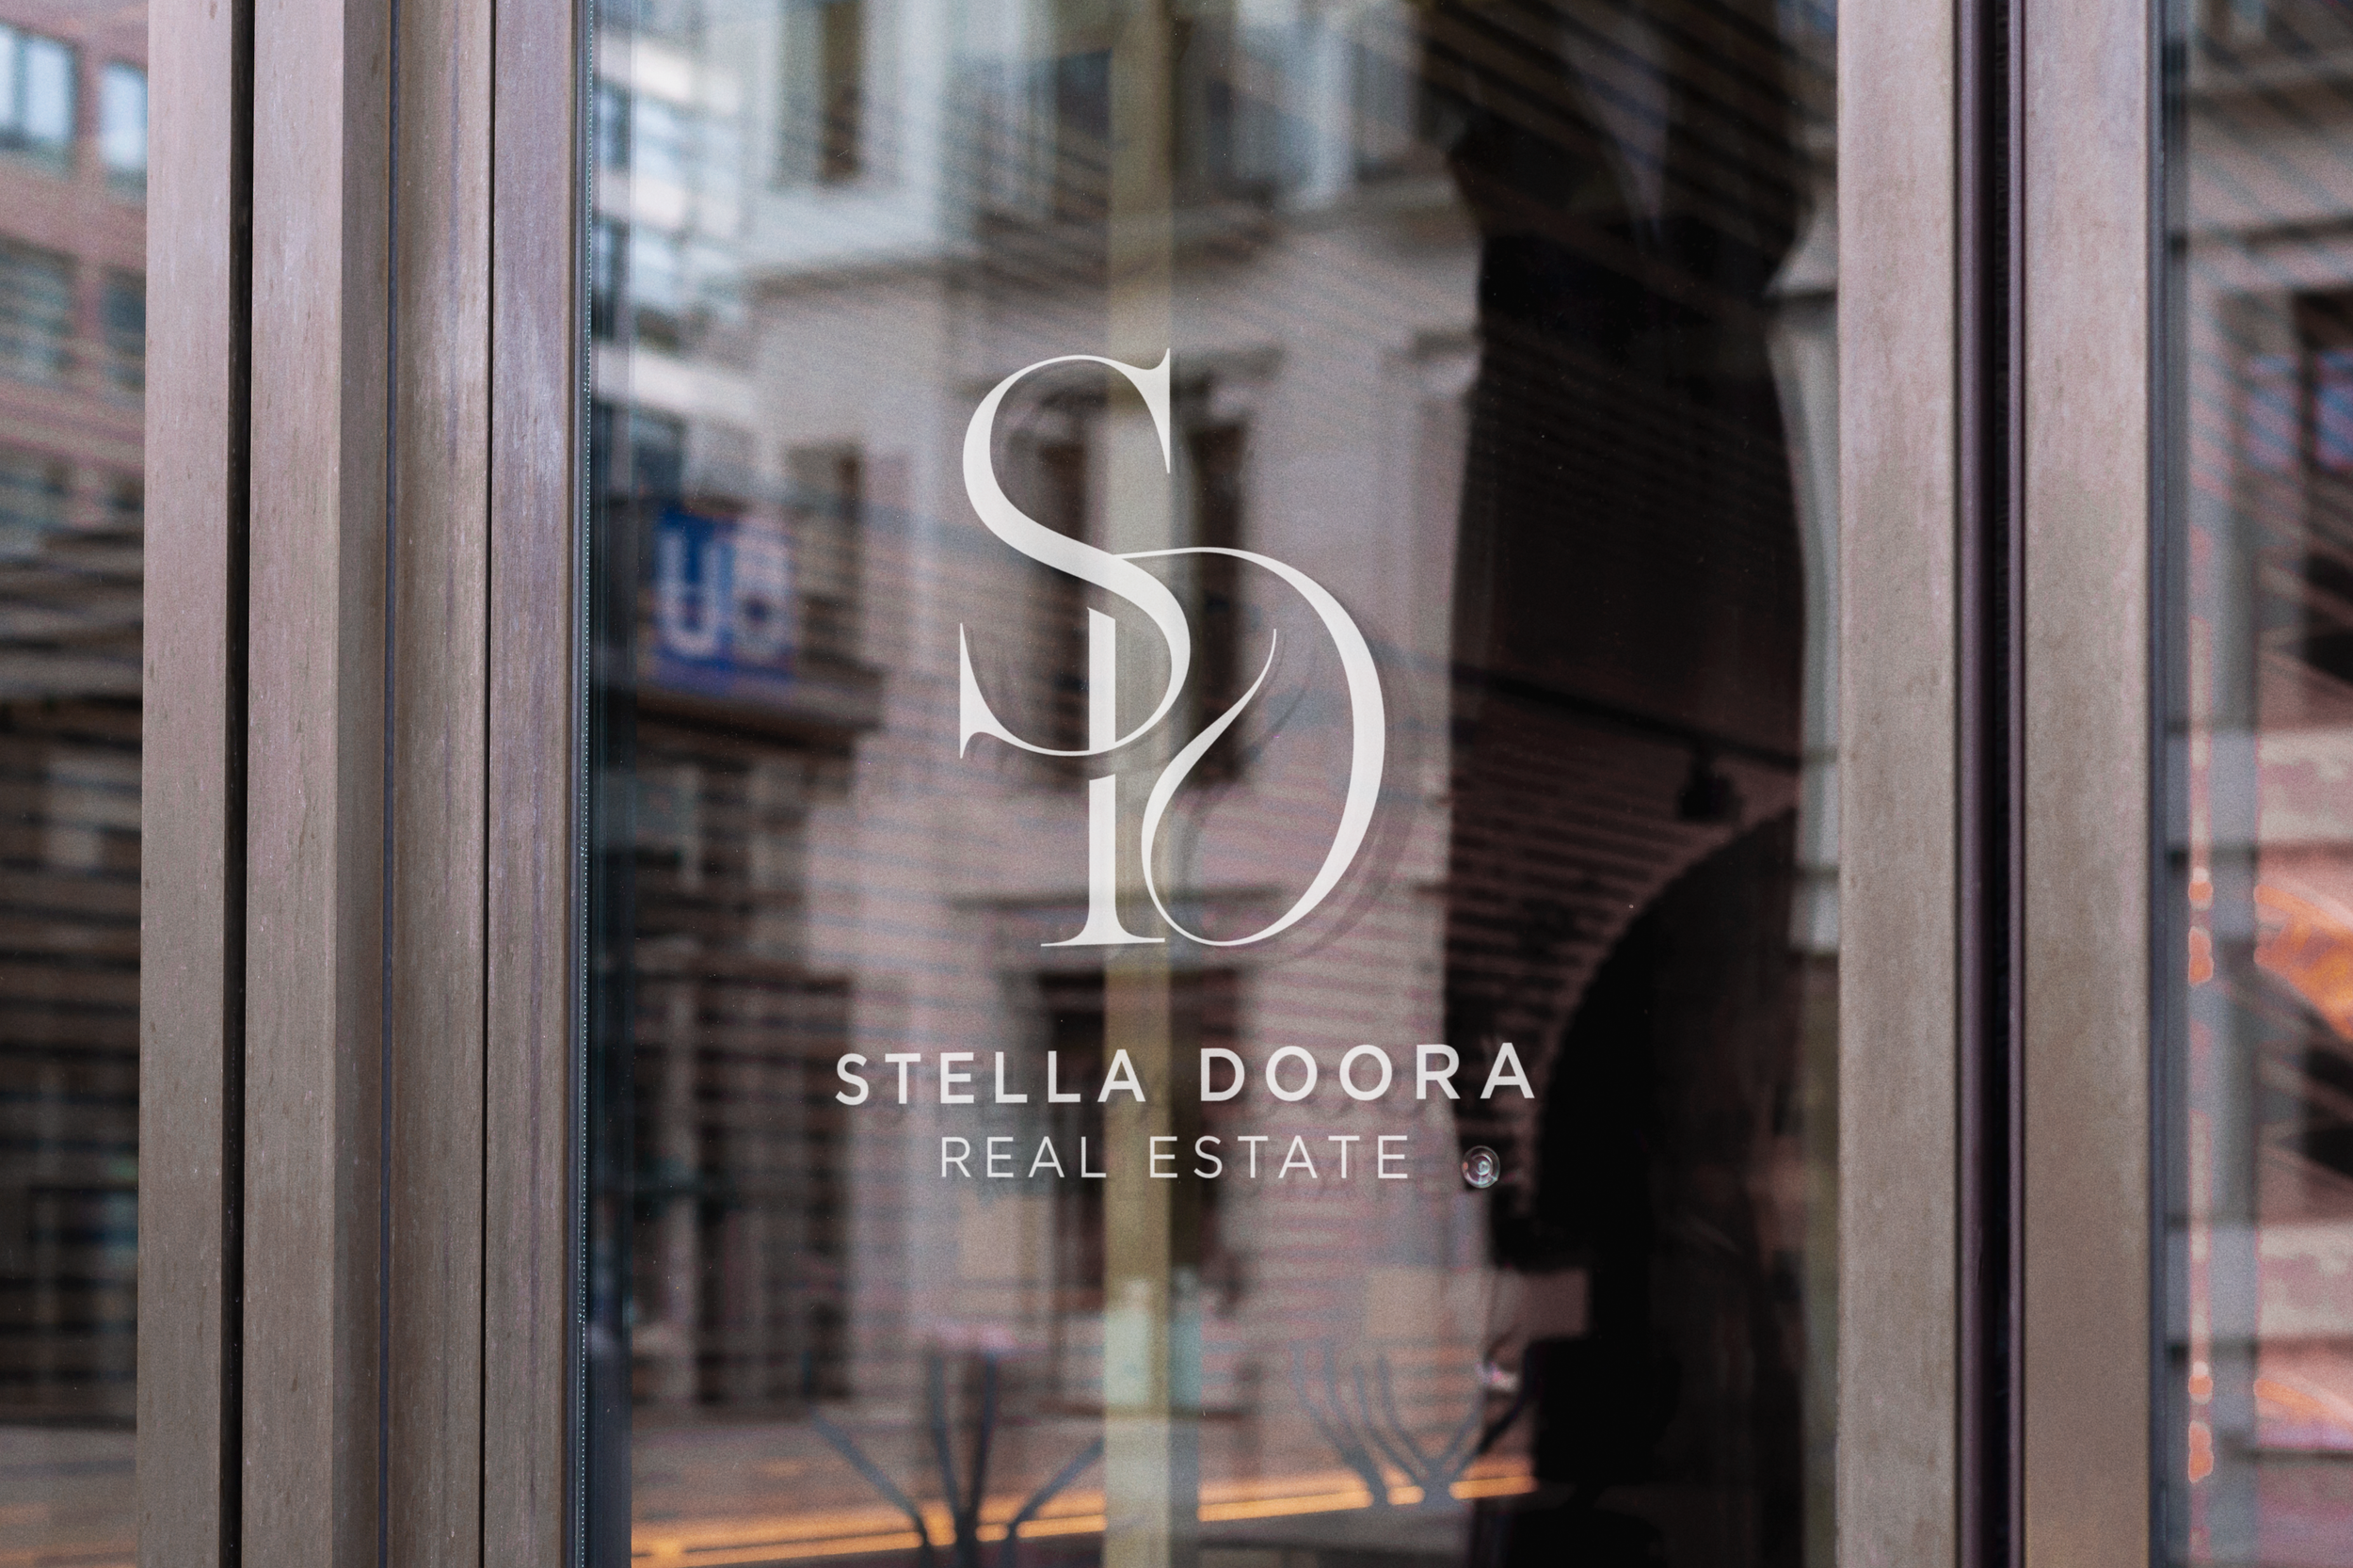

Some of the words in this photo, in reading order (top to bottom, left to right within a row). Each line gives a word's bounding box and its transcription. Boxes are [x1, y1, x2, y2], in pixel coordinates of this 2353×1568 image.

[835, 1048, 1146, 1106] STELLA
[1200, 1043, 1535, 1102] DOORA
[941, 1136, 1107, 1178] REAL
[1149, 1135, 1408, 1179] ESTATE
